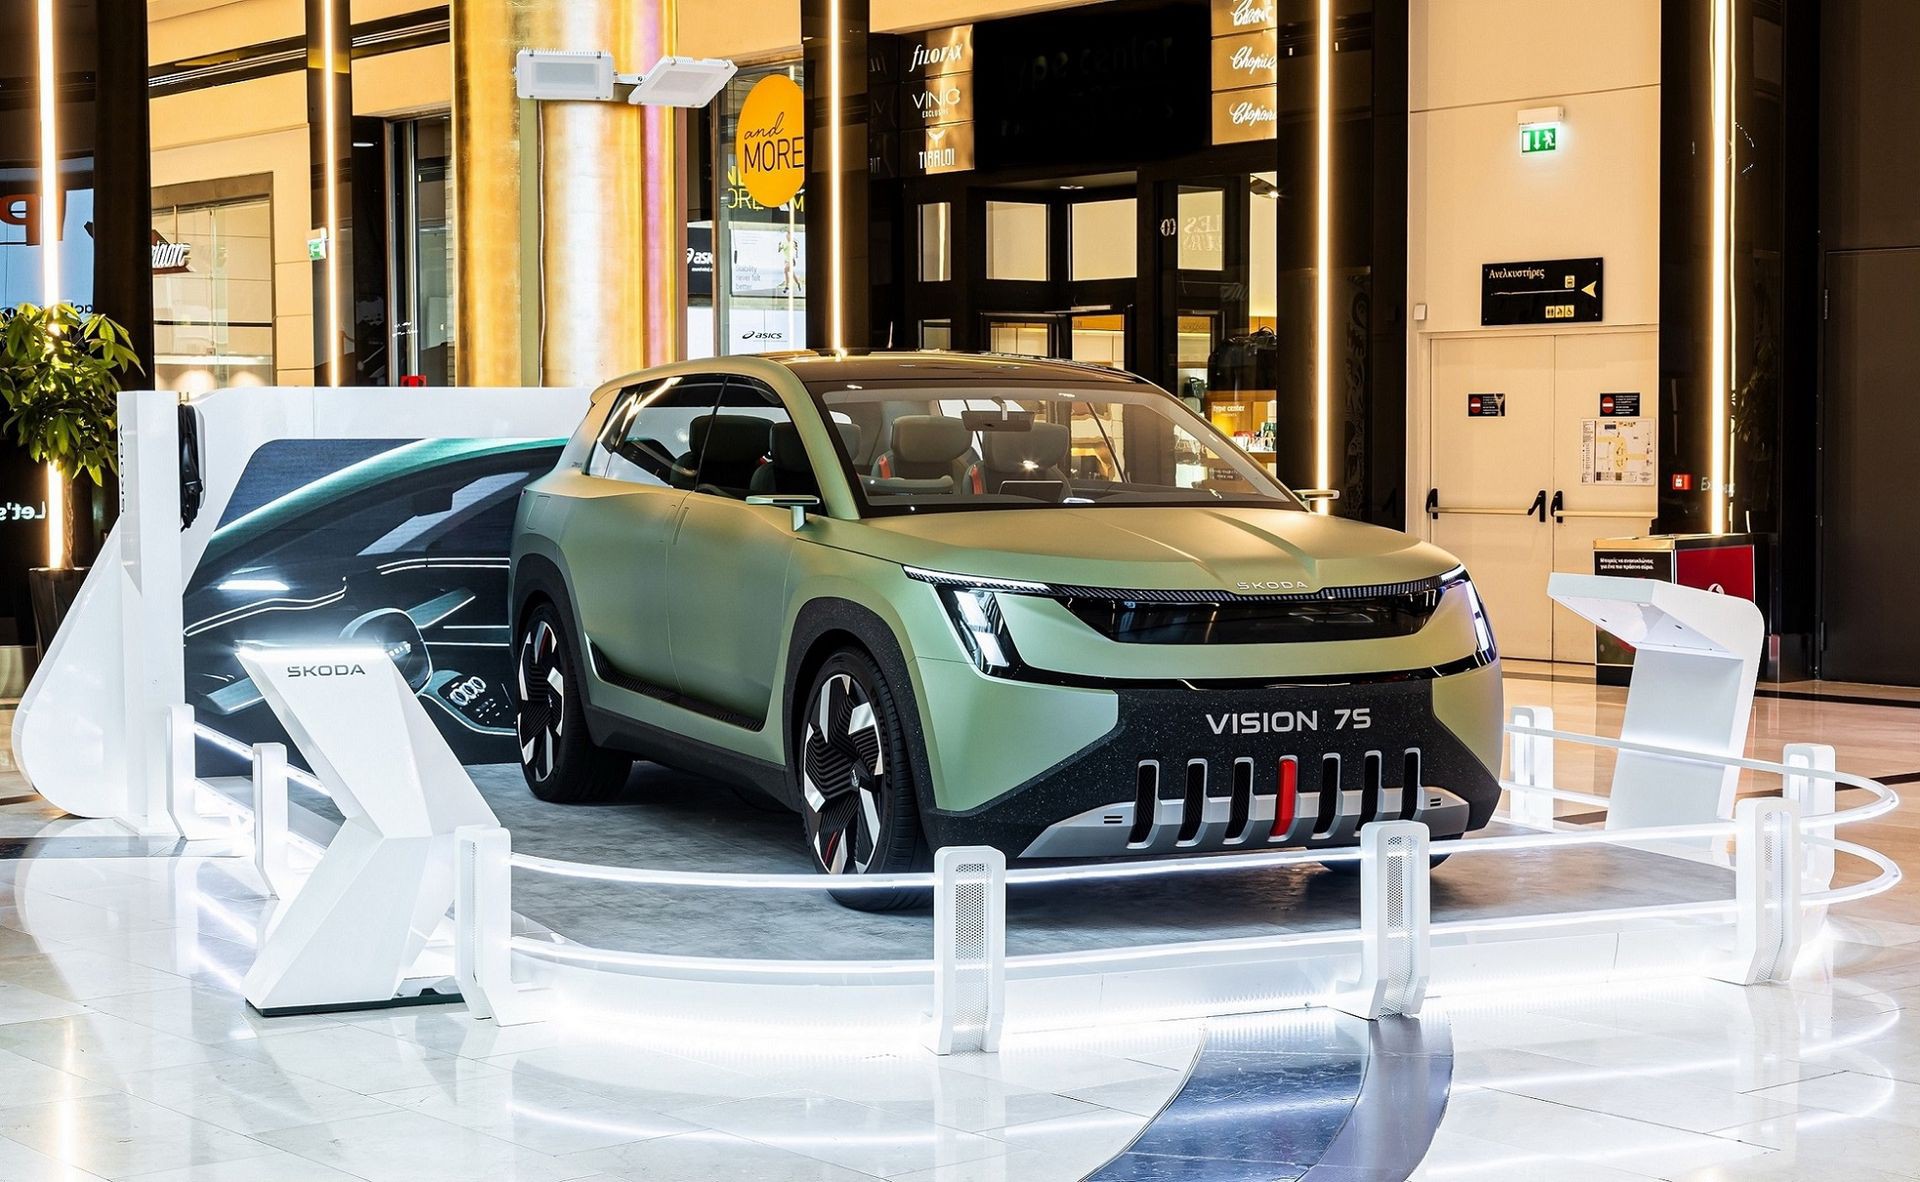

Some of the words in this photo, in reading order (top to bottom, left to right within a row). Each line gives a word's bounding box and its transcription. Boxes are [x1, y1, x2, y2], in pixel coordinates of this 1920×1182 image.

[744, 111, 785, 140] and
[744, 136, 804, 174] MORE
[1488, 266, 1545, 280] Ανελκυστήρες
[1205, 710, 1318, 735] VISION
[1333, 708, 1372, 730] 7S
